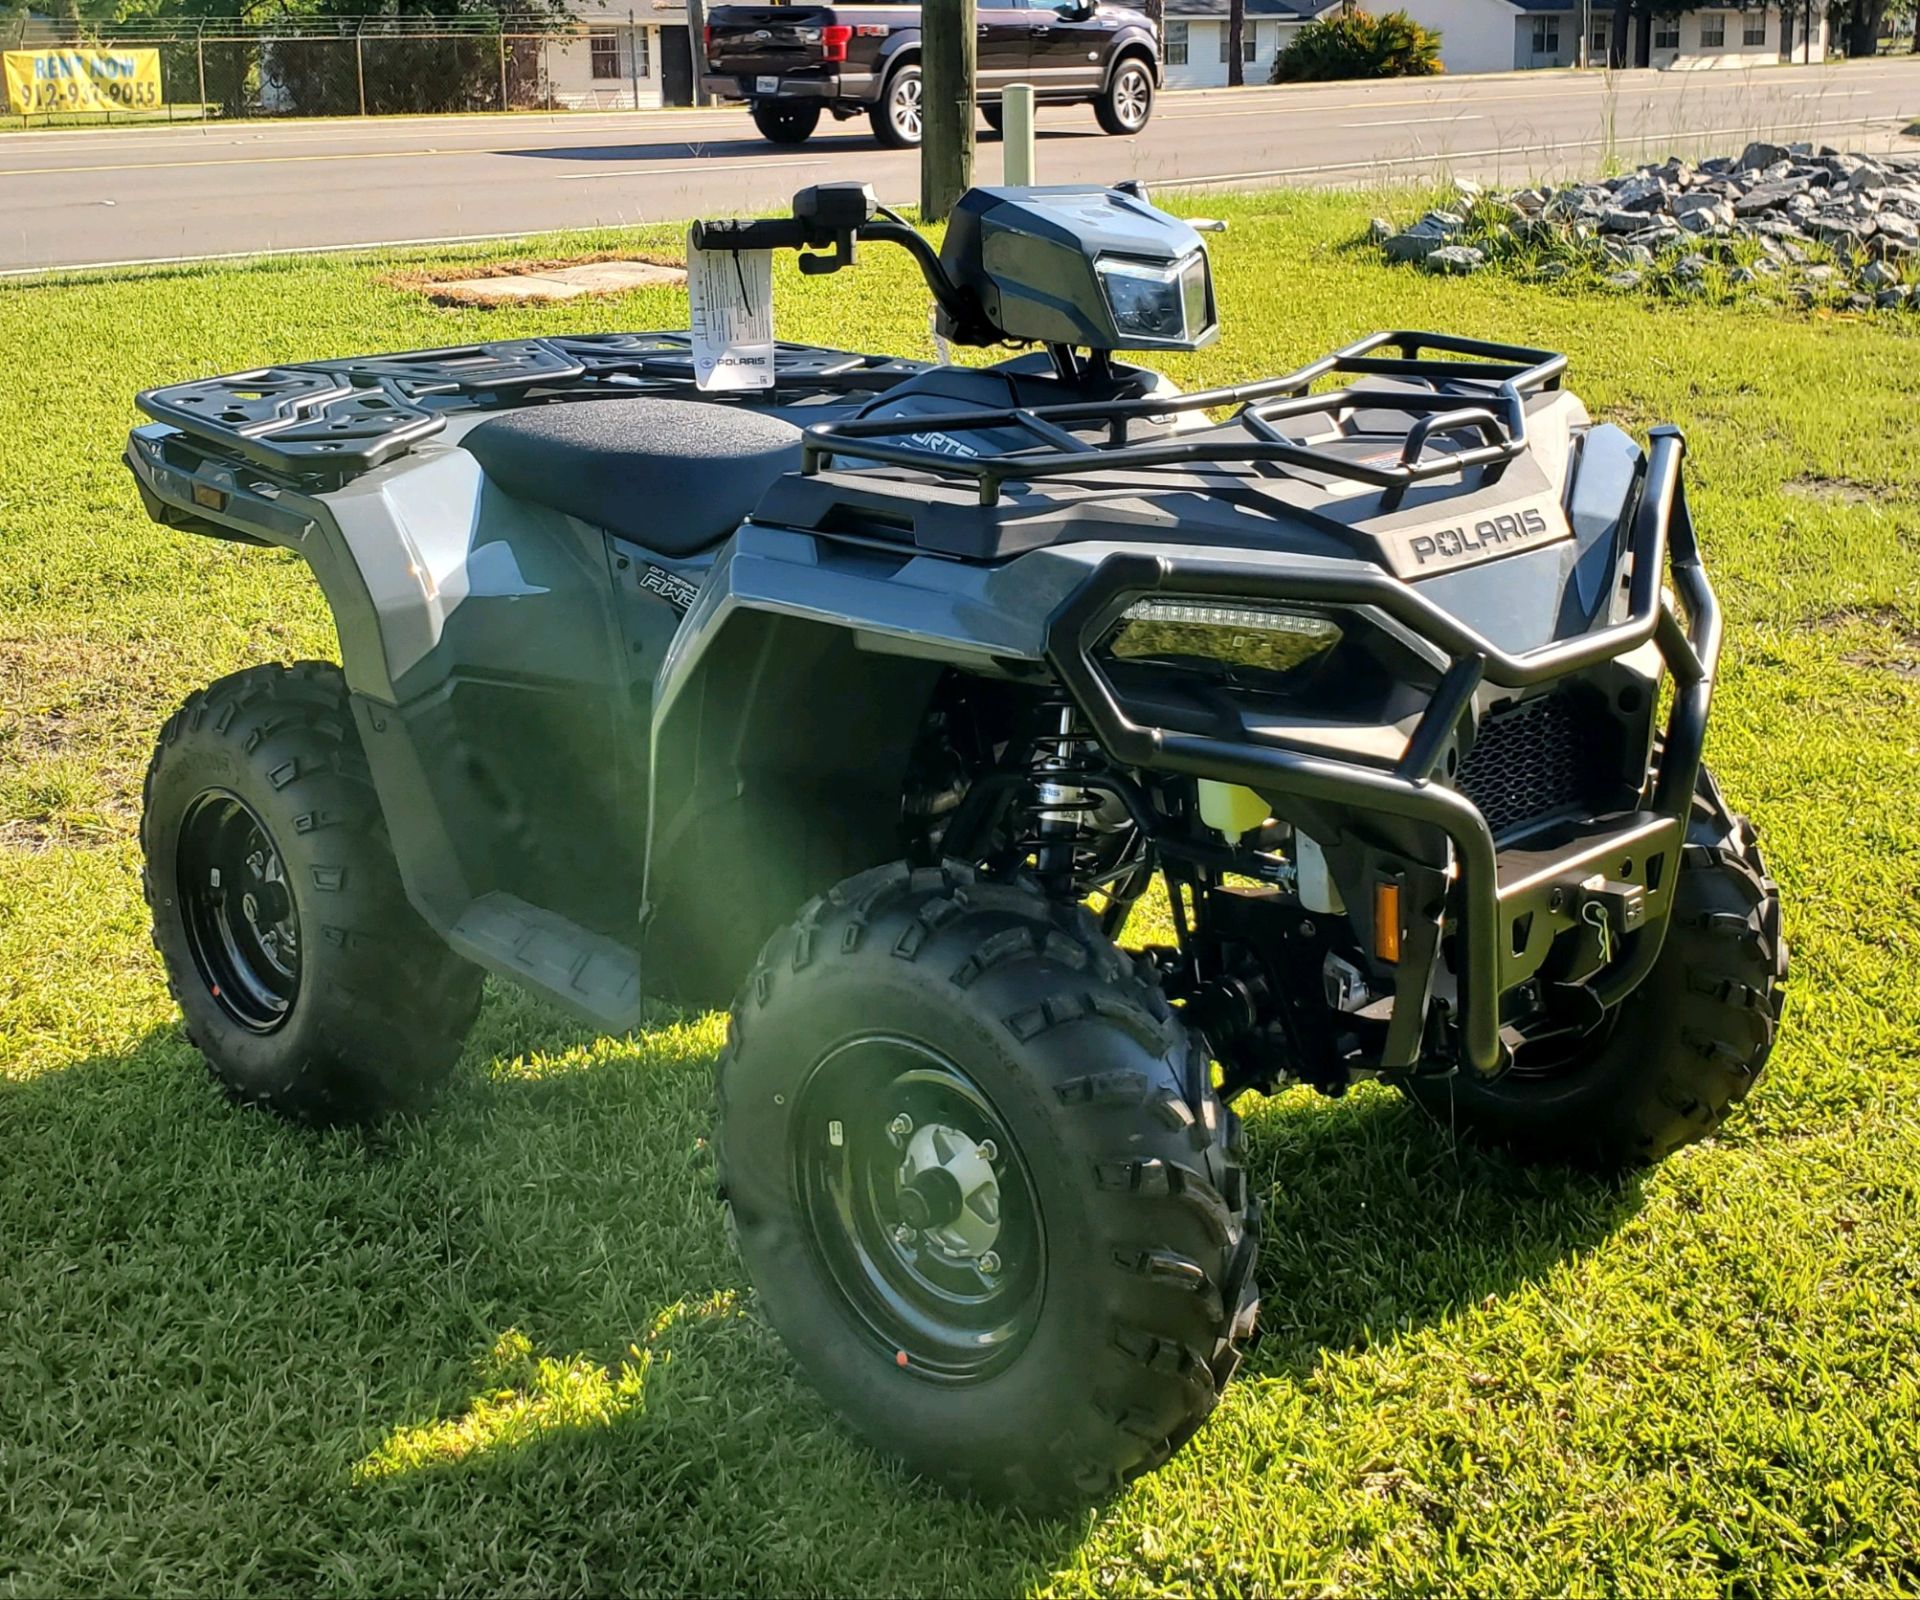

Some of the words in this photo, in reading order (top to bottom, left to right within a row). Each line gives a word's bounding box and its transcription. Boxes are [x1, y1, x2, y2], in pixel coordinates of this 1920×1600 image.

[35, 56, 83, 79] RENT
[90, 56, 134, 79] NOW
[717, 357, 766, 366] POLARIS
[1409, 508, 1546, 564] POLARIS
[640, 572, 697, 609] AWD
